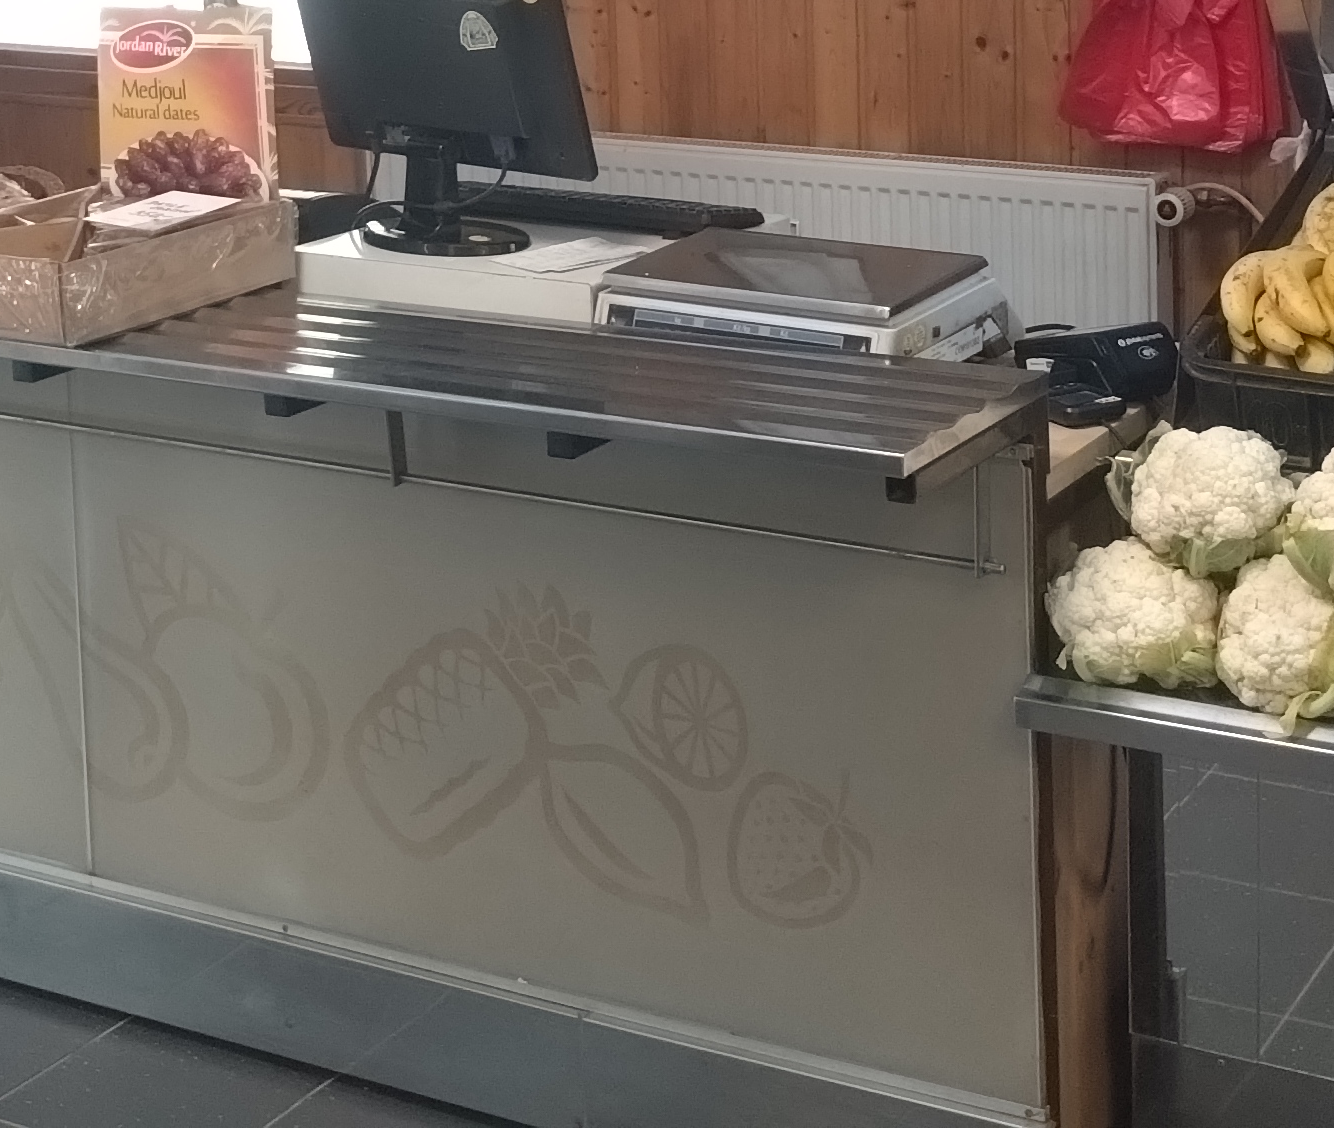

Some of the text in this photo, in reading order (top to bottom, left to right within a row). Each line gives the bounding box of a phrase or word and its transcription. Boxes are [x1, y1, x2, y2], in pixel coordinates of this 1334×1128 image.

[115, 36, 188, 58] Jordan River
[121, 77, 188, 104] Medjoul
[112, 103, 201, 121] Natural dates
